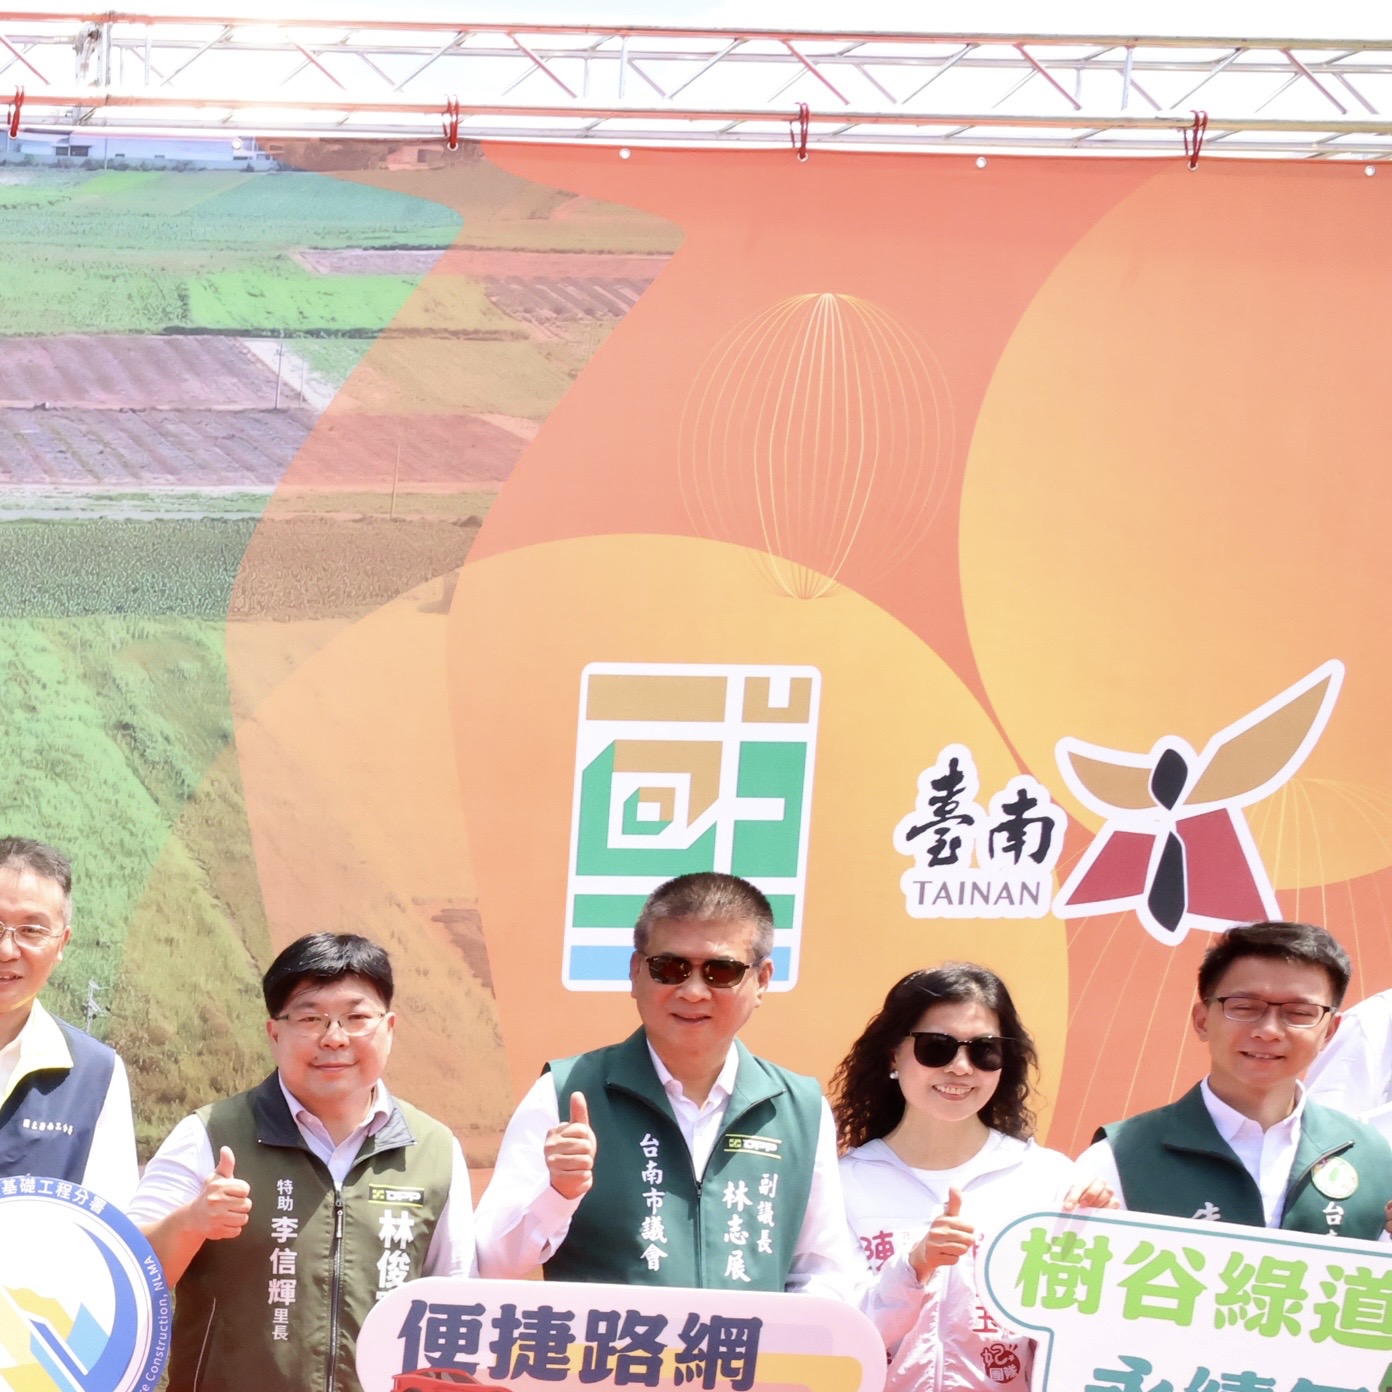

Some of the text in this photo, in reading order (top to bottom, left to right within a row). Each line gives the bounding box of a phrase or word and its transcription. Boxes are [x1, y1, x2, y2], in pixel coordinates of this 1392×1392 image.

[906, 757, 1055, 868] 臺南
[913, 881, 1041, 905] TAINAN
[639, 1132, 669, 1272] 台南市議會
[722, 1180, 754, 1283] 林志展
[756, 1173, 779, 1254] 副議長
[143, 1255, 165, 1292] NLMA
[375, 1208, 415, 1300] 林俊
[1014, 1227, 1392, 1351] 樹谷綠道
[146, 1294, 169, 1382] Construction,
[396, 1299, 764, 1392] 便捷路網
